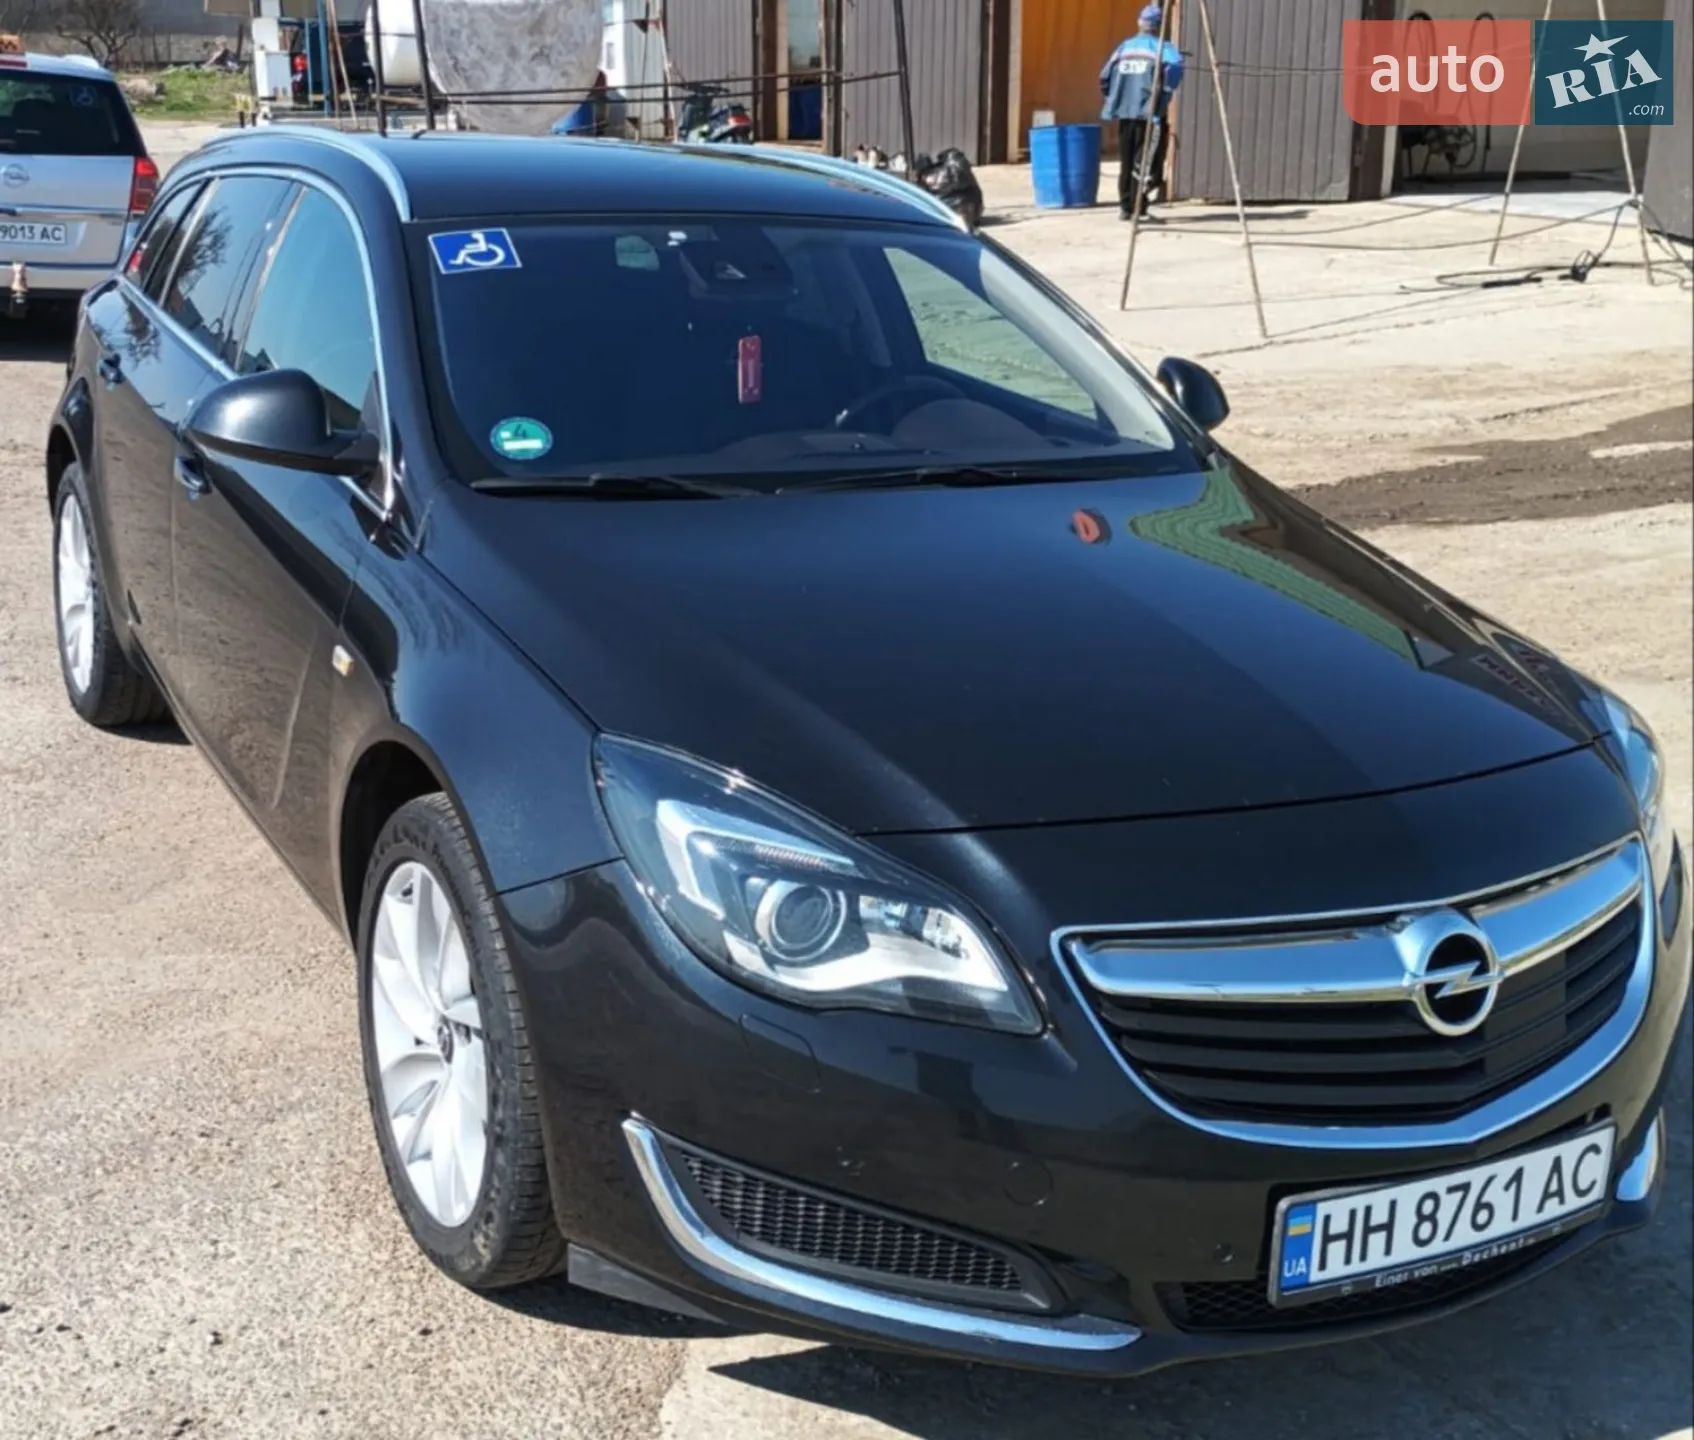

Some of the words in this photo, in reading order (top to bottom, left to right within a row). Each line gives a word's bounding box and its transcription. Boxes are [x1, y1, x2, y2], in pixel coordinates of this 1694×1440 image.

[0, 225, 35, 240] 9013
[40, 226, 62, 241] AC
[1318, 1200, 1397, 1272] HH
[1412, 1166, 1525, 1248] 8761
[1536, 1143, 1602, 1213] AC
[1283, 1257, 1307, 1278] UA
